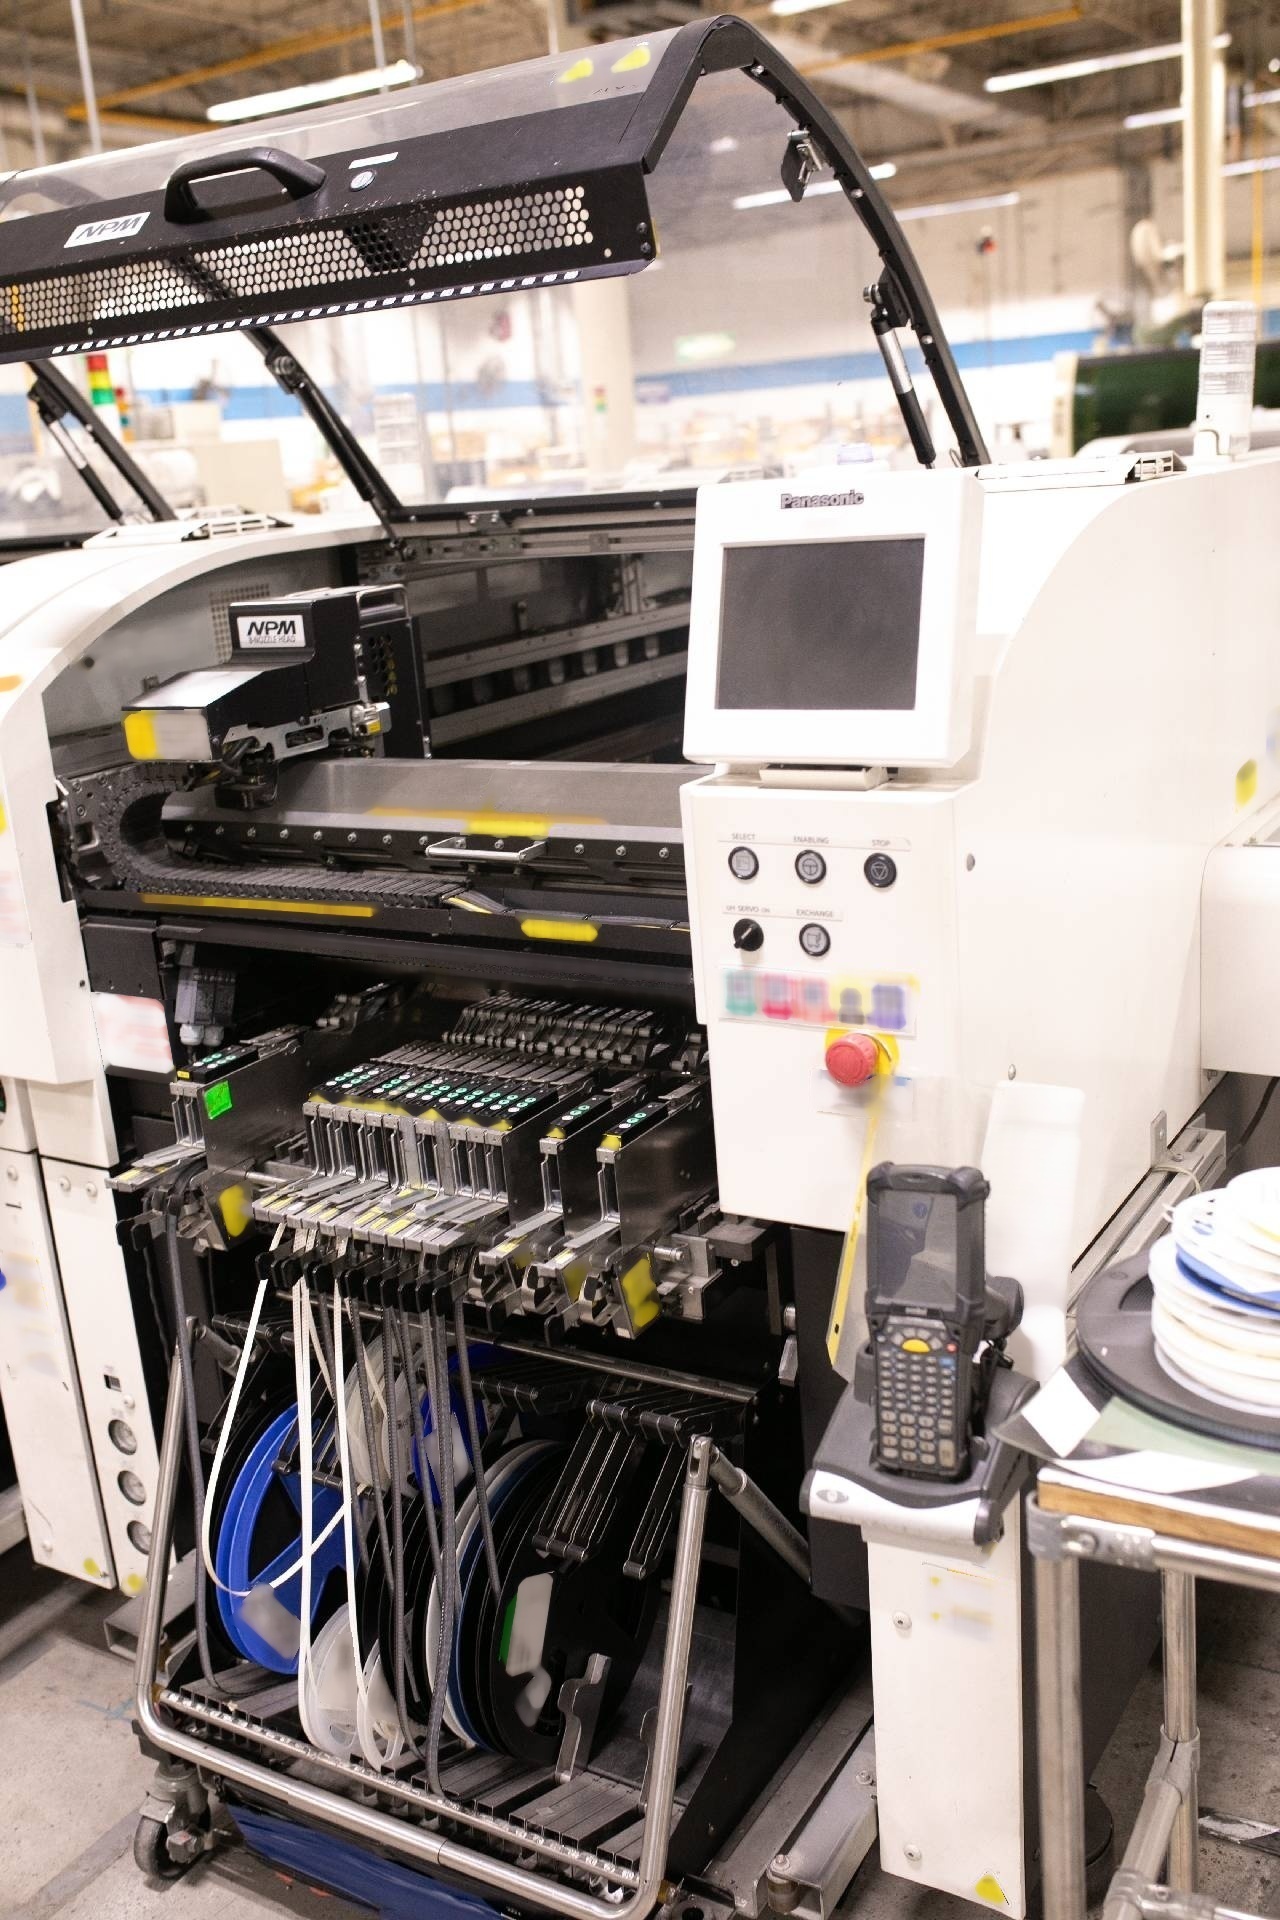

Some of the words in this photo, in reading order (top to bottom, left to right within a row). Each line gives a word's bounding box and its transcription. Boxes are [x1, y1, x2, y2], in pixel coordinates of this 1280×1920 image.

[75, 216, 142, 240] NPM
[780, 489, 864, 509] Panasonic
[247, 620, 296, 636] NPM
[731, 833, 756, 841] SELECT
[793, 835, 829, 845] ENABLING
[871, 839, 891, 847] STOP
[737, 905, 760, 913] SERVO
[796, 908, 833, 918] EXCHANGE
